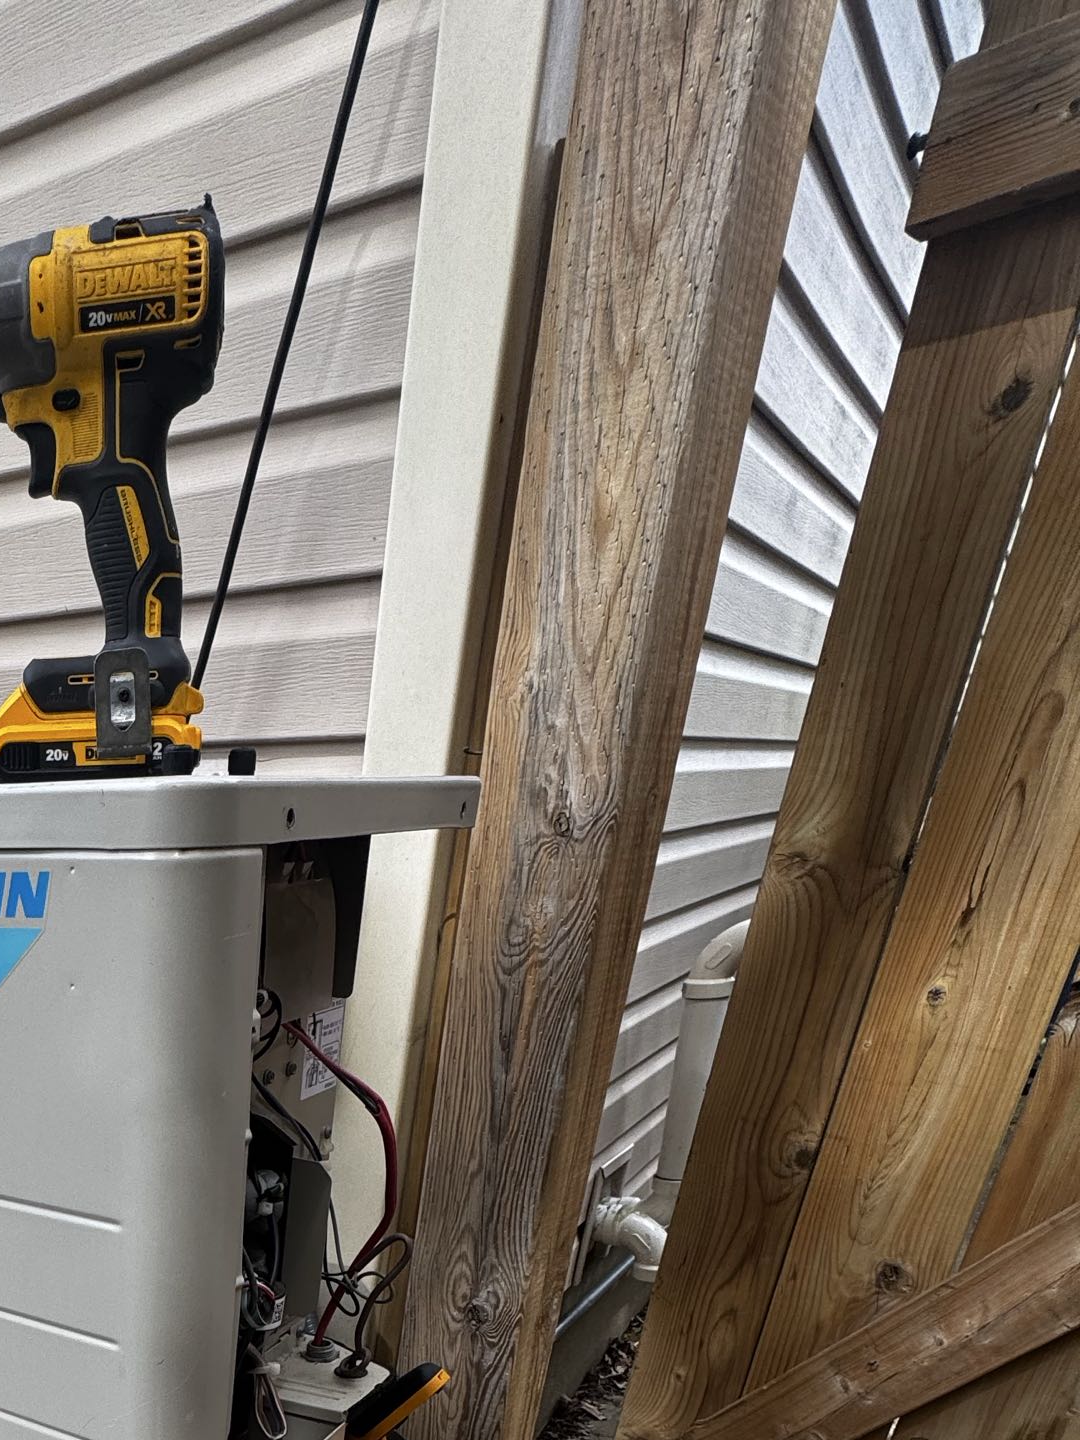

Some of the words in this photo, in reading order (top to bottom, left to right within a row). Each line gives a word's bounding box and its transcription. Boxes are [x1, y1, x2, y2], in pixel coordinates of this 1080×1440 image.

[76, 260, 176, 299] DEWALT
[145, 301, 167, 321] XR
[152, 741, 163, 756] 2
